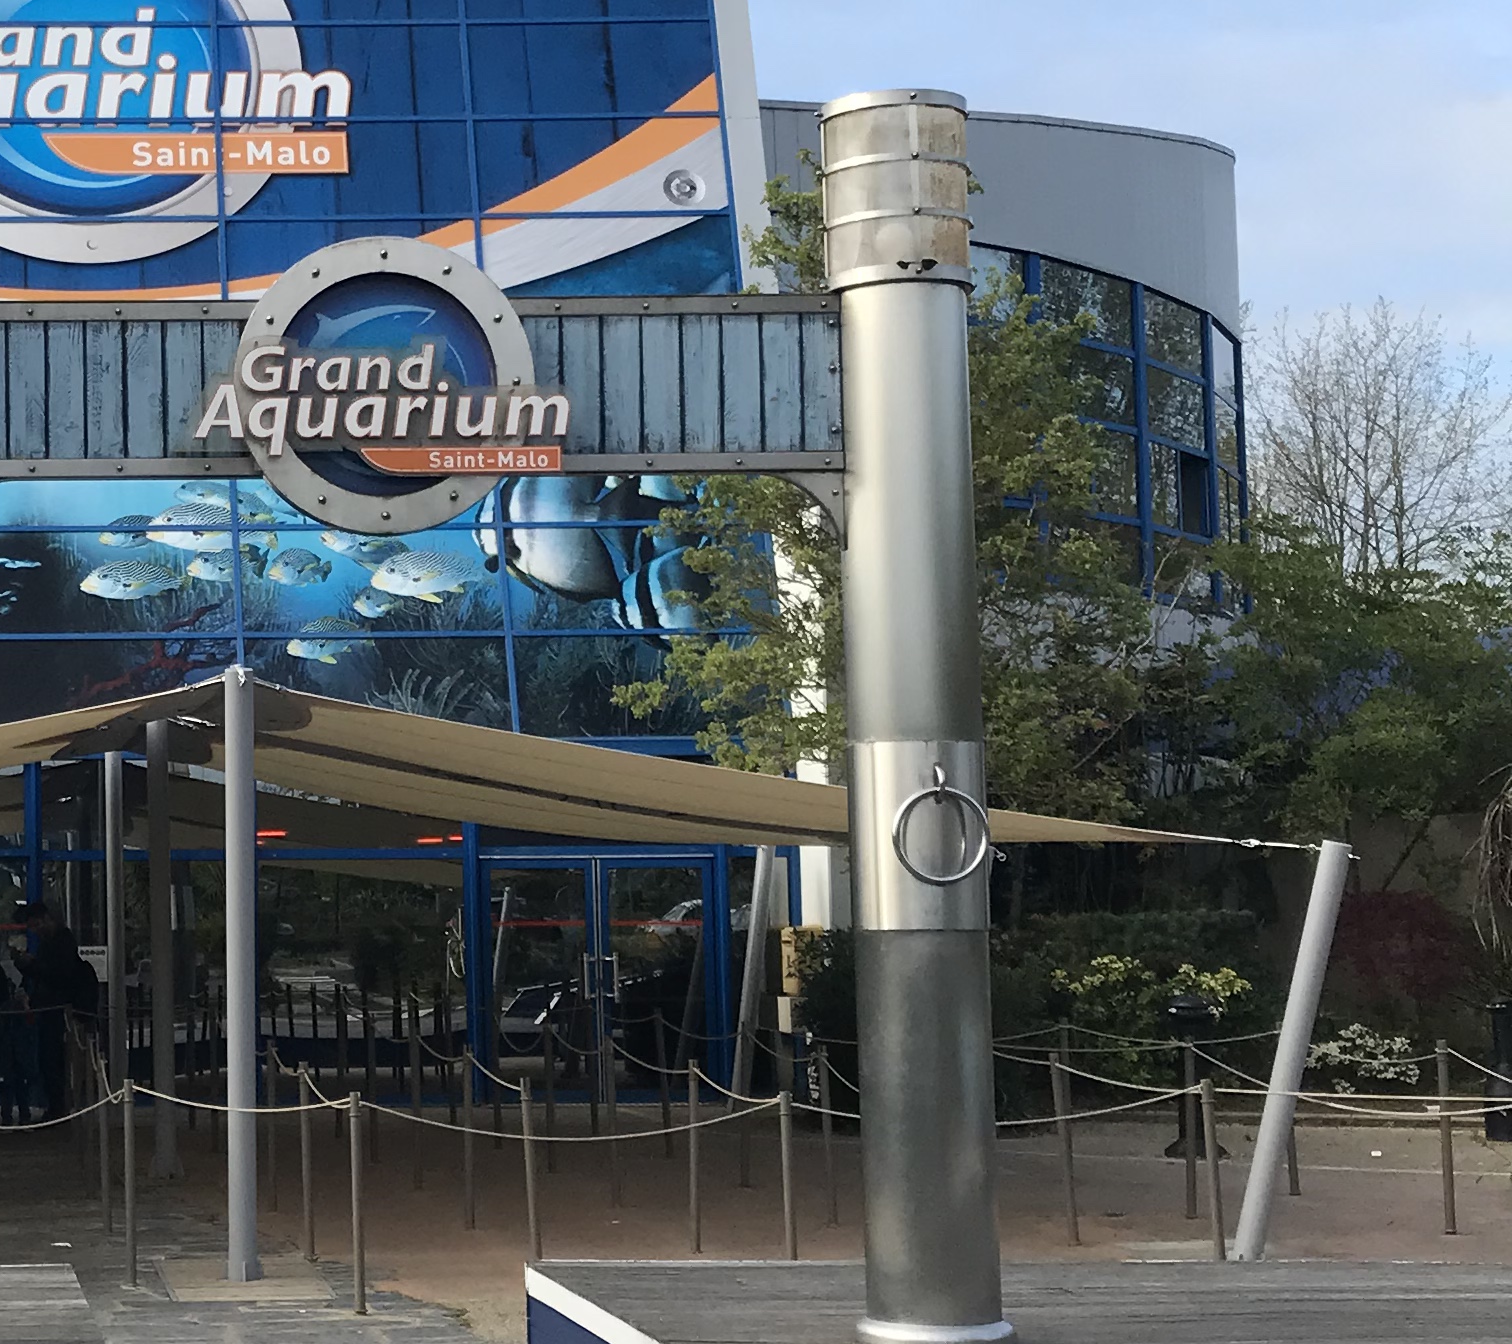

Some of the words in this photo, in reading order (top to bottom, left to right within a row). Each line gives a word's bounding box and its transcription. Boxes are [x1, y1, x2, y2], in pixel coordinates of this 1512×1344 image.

[131, 140, 331, 167] Sain-Malo
[240, 343, 436, 394] Grand
[193, 381, 571, 457] Aquarium
[428, 451, 550, 469] Saint-Malo
